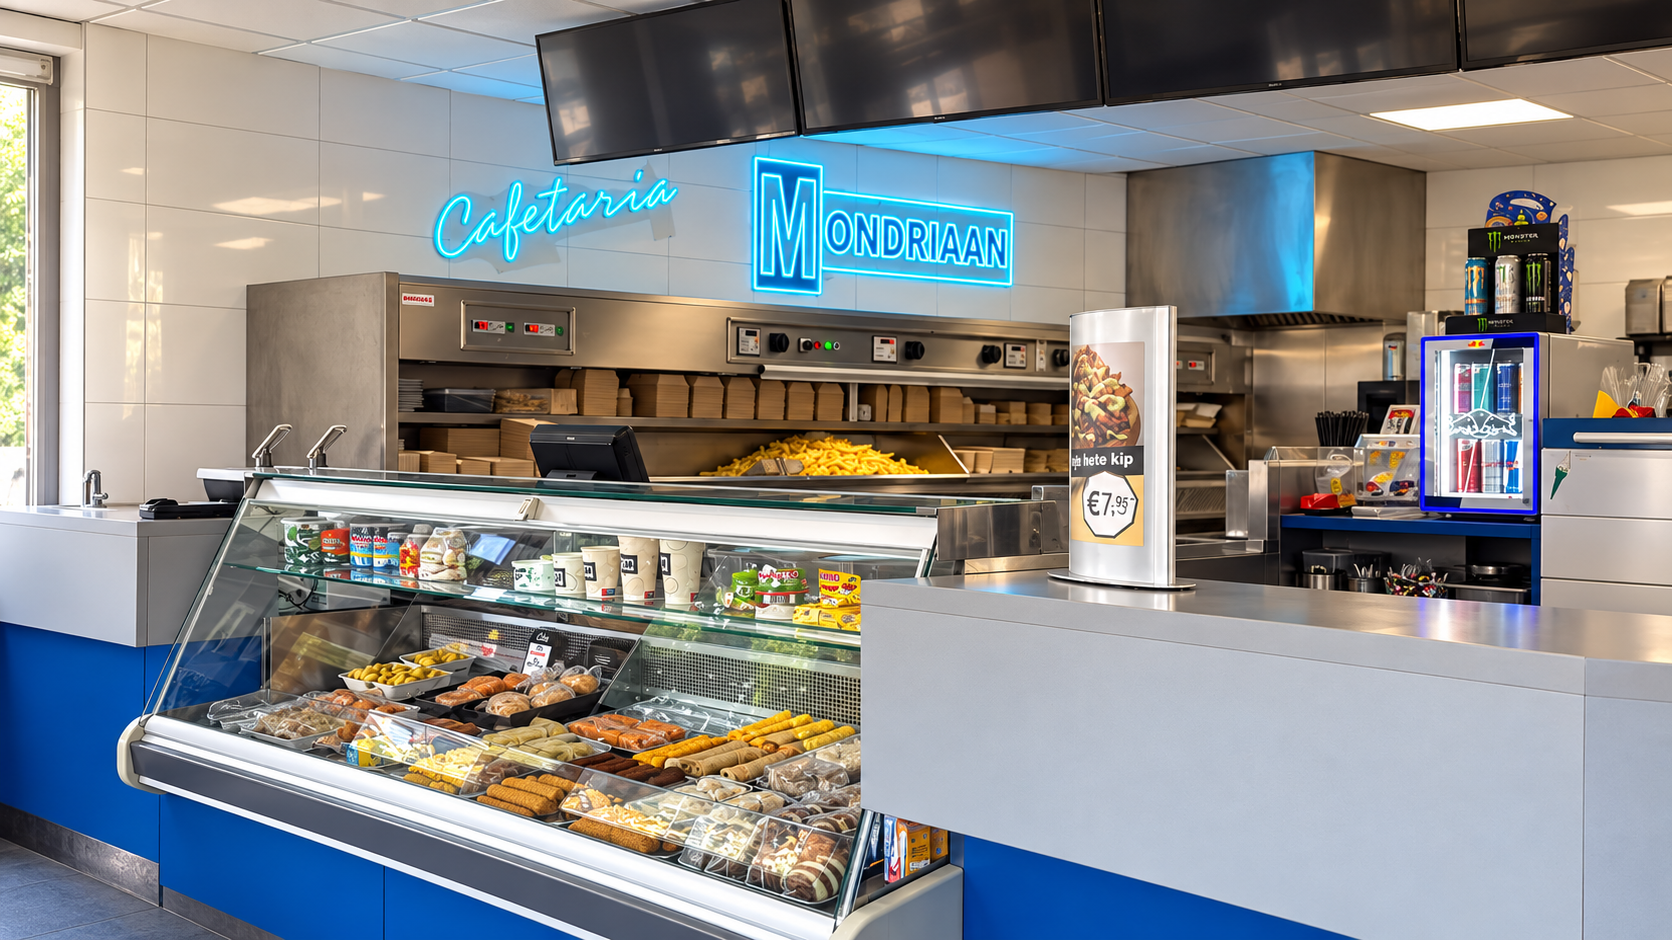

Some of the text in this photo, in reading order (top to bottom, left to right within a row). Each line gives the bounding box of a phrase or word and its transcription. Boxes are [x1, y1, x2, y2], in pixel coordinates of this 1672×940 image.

[434, 169, 679, 262] Cafetaria
[760, 172, 1009, 280] MONDRIAAN
[1083, 453, 1107, 466] hete
[1111, 452, 1134, 468] kip
